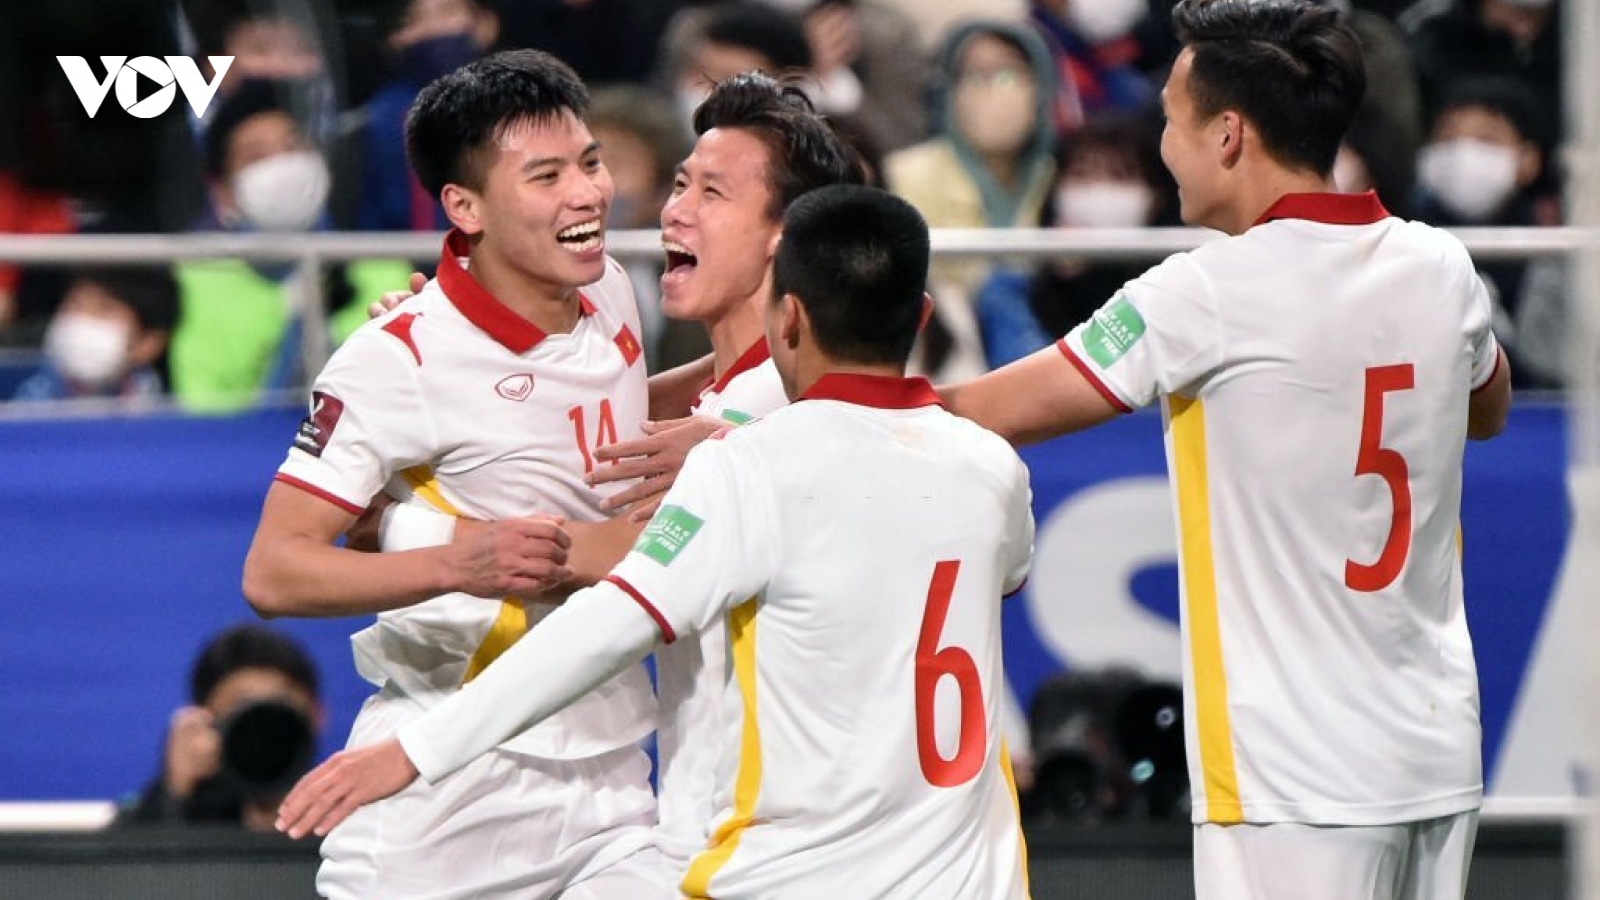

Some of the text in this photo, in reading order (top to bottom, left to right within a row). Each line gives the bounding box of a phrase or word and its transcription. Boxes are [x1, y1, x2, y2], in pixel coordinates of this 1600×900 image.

[567, 397, 619, 488] 14
[1345, 364, 1415, 592] 5
[914, 560, 987, 788] 6
